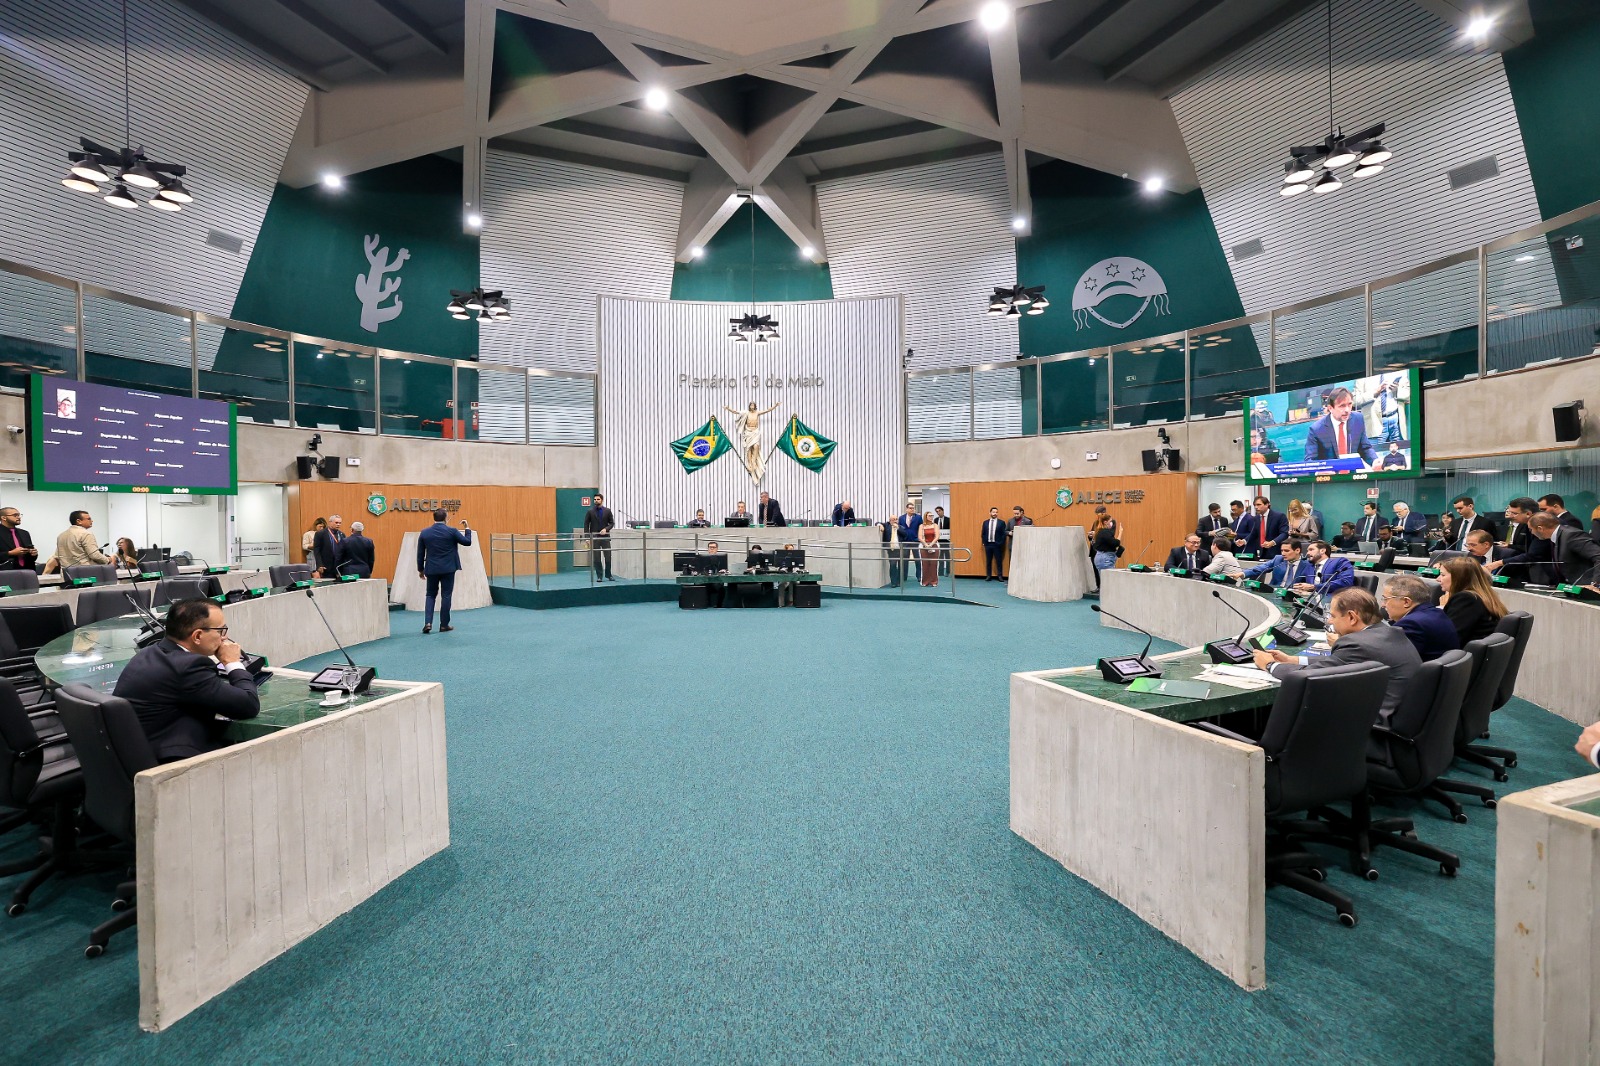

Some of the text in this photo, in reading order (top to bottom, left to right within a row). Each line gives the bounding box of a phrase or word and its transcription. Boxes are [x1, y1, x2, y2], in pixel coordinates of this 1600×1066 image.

[679, 373, 824, 389] Plenário 13 de Maio
[1076, 490, 1122, 504] ALECE
[390, 498, 439, 512] ALECE
